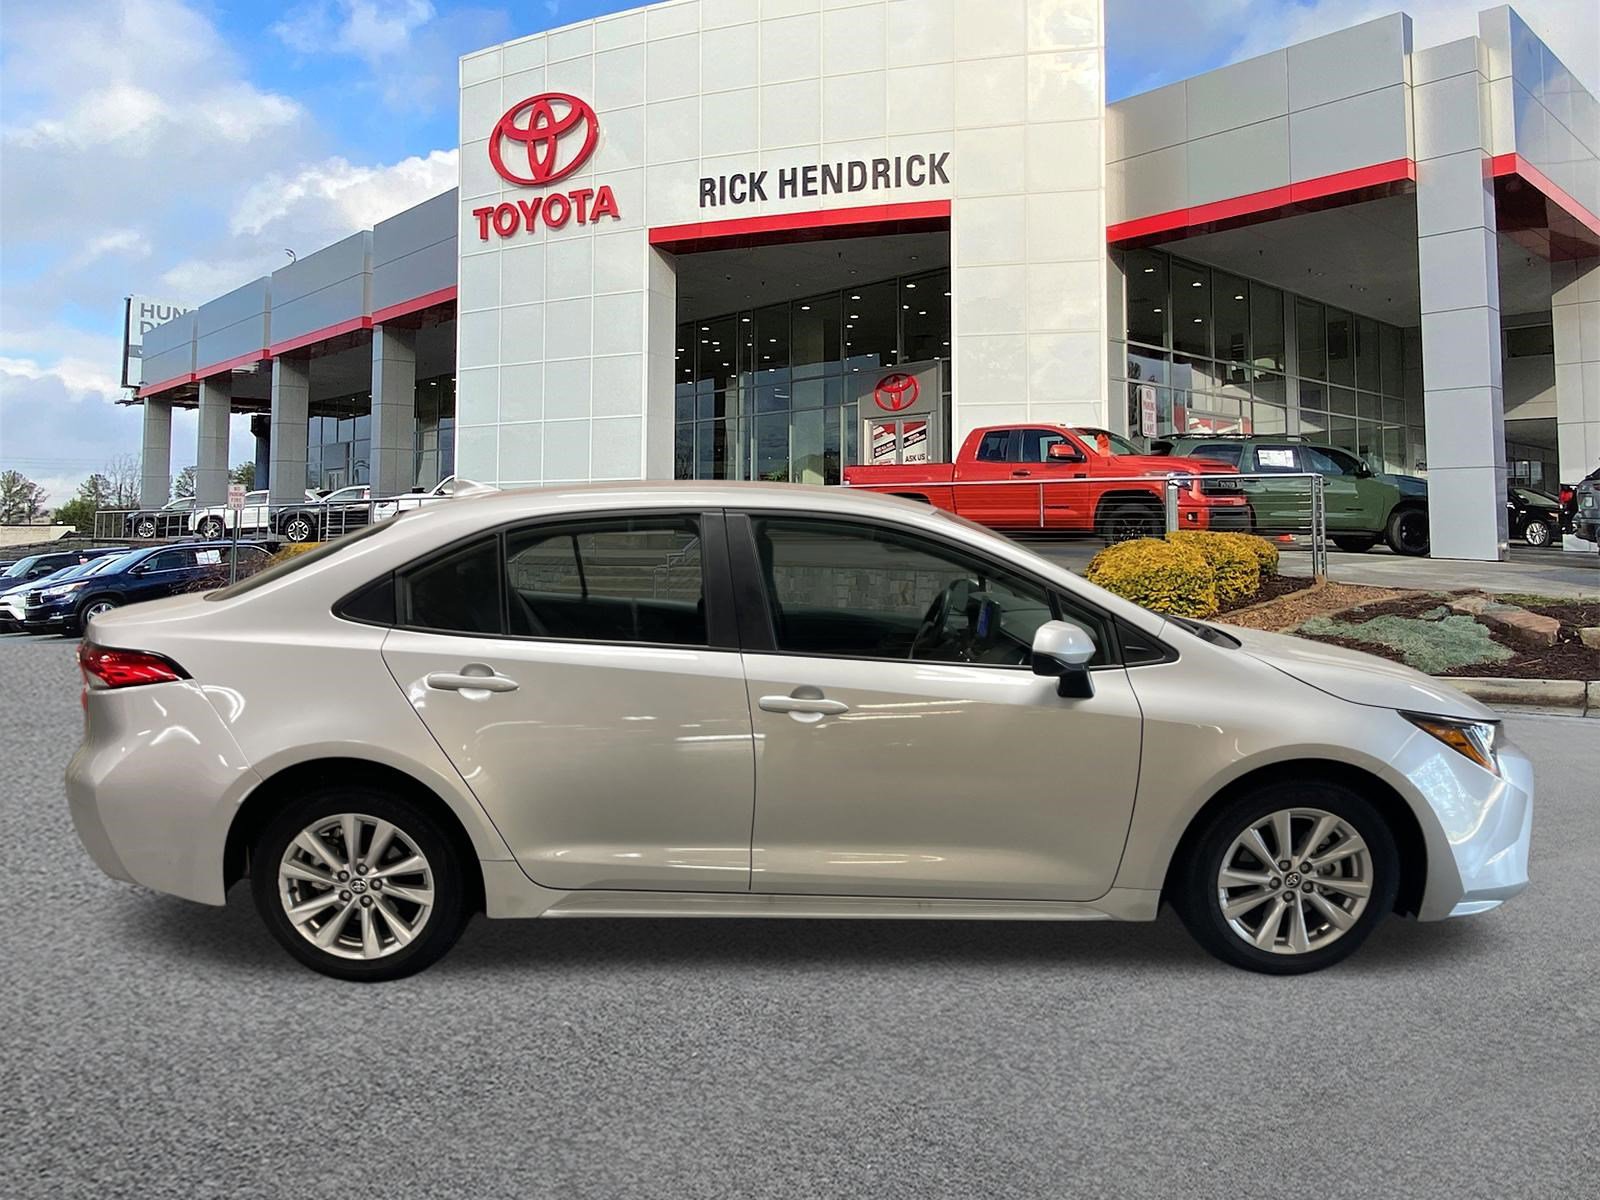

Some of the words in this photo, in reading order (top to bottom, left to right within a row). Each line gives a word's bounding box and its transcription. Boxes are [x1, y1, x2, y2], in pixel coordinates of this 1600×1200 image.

[699, 170, 768, 208] RICK
[778, 152, 950, 199] HENDRICK
[472, 185, 620, 240] TOYOTA
[917, 453, 926, 461] US
